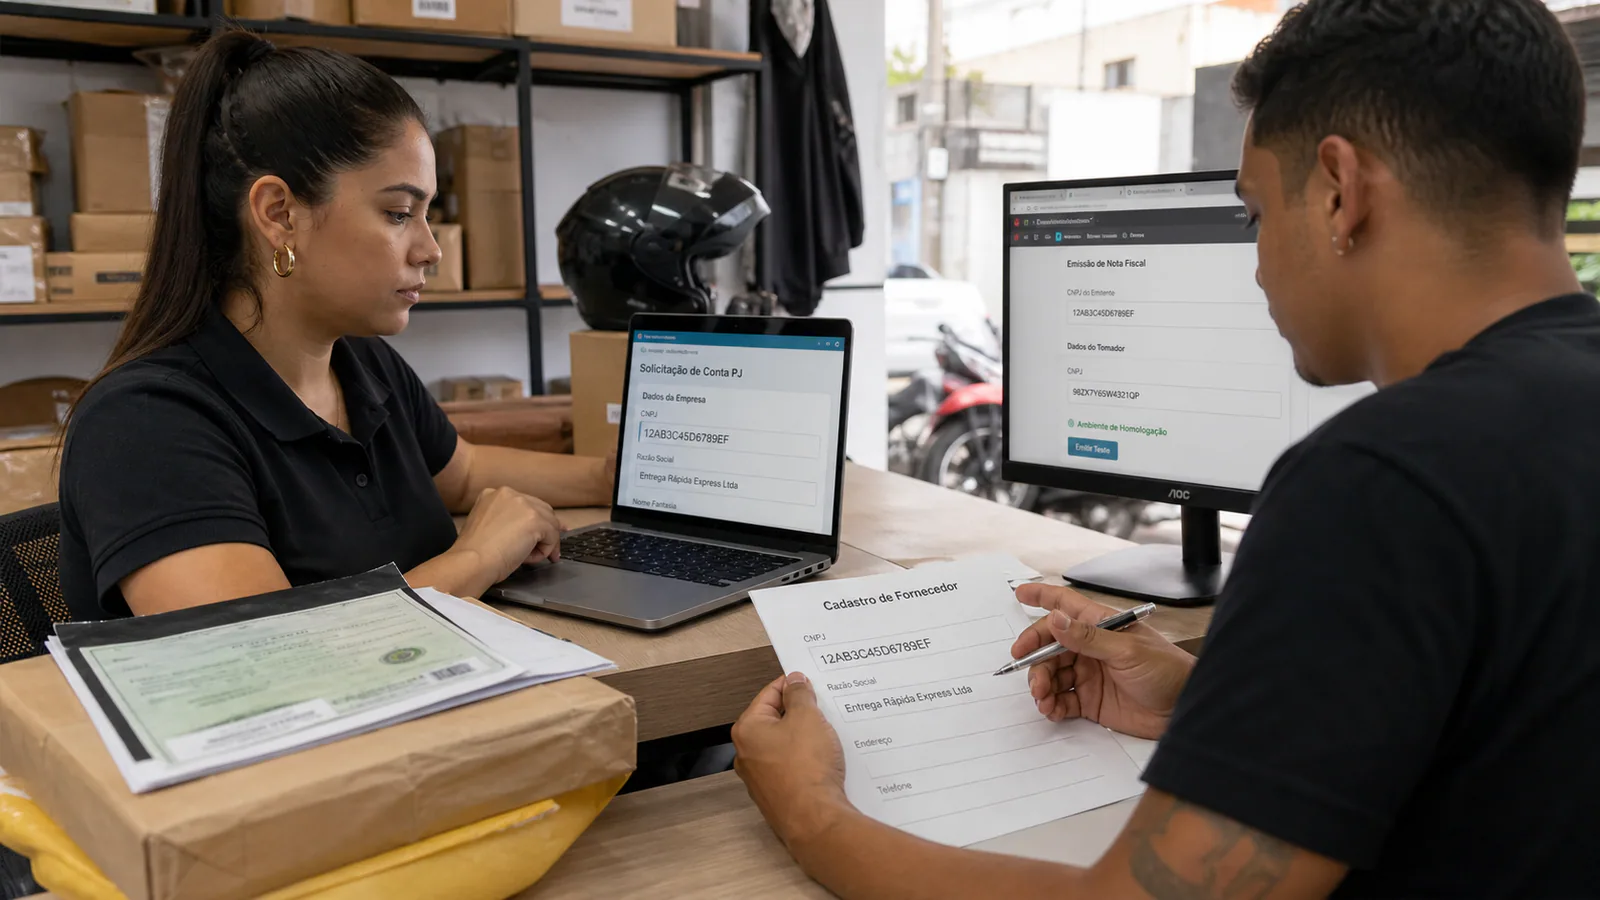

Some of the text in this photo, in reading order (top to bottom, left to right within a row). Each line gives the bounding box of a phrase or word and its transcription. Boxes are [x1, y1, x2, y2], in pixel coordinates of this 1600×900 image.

[1067, 259, 1146, 268] Emissão de Nota Fiscal
[1067, 289, 1082, 297] CNPJ
[1067, 343, 1125, 352] Dados do Tomador
[640, 363, 742, 378] Solicitação de Conta PJ
[1067, 367, 1083, 376] CNPJ
[642, 392, 706, 404] Dados da Empresa
[640, 410, 658, 418] CNPJ
[1077, 420, 1168, 437] Ambiente de Homologação
[644, 428, 730, 444] 12AB3C45D6789EF
[636, 453, 674, 463] Razão Social
[640, 472, 738, 490] Entrega Rápida Express Ltda
[1168, 488, 1190, 500] AOC
[632, 498, 677, 510] Nome Fantasia
[822, 581, 959, 612] Cadastro de Fornecedor
[803, 632, 827, 644] CNPJ
[820, 637, 932, 665] 12AB3C45D6789EF
[826, 676, 877, 692] Razão Social
[844, 684, 974, 714] Entrega Rápida Express Ltda
[854, 735, 893, 749] Endereço
[877, 781, 912, 796] Telefone
